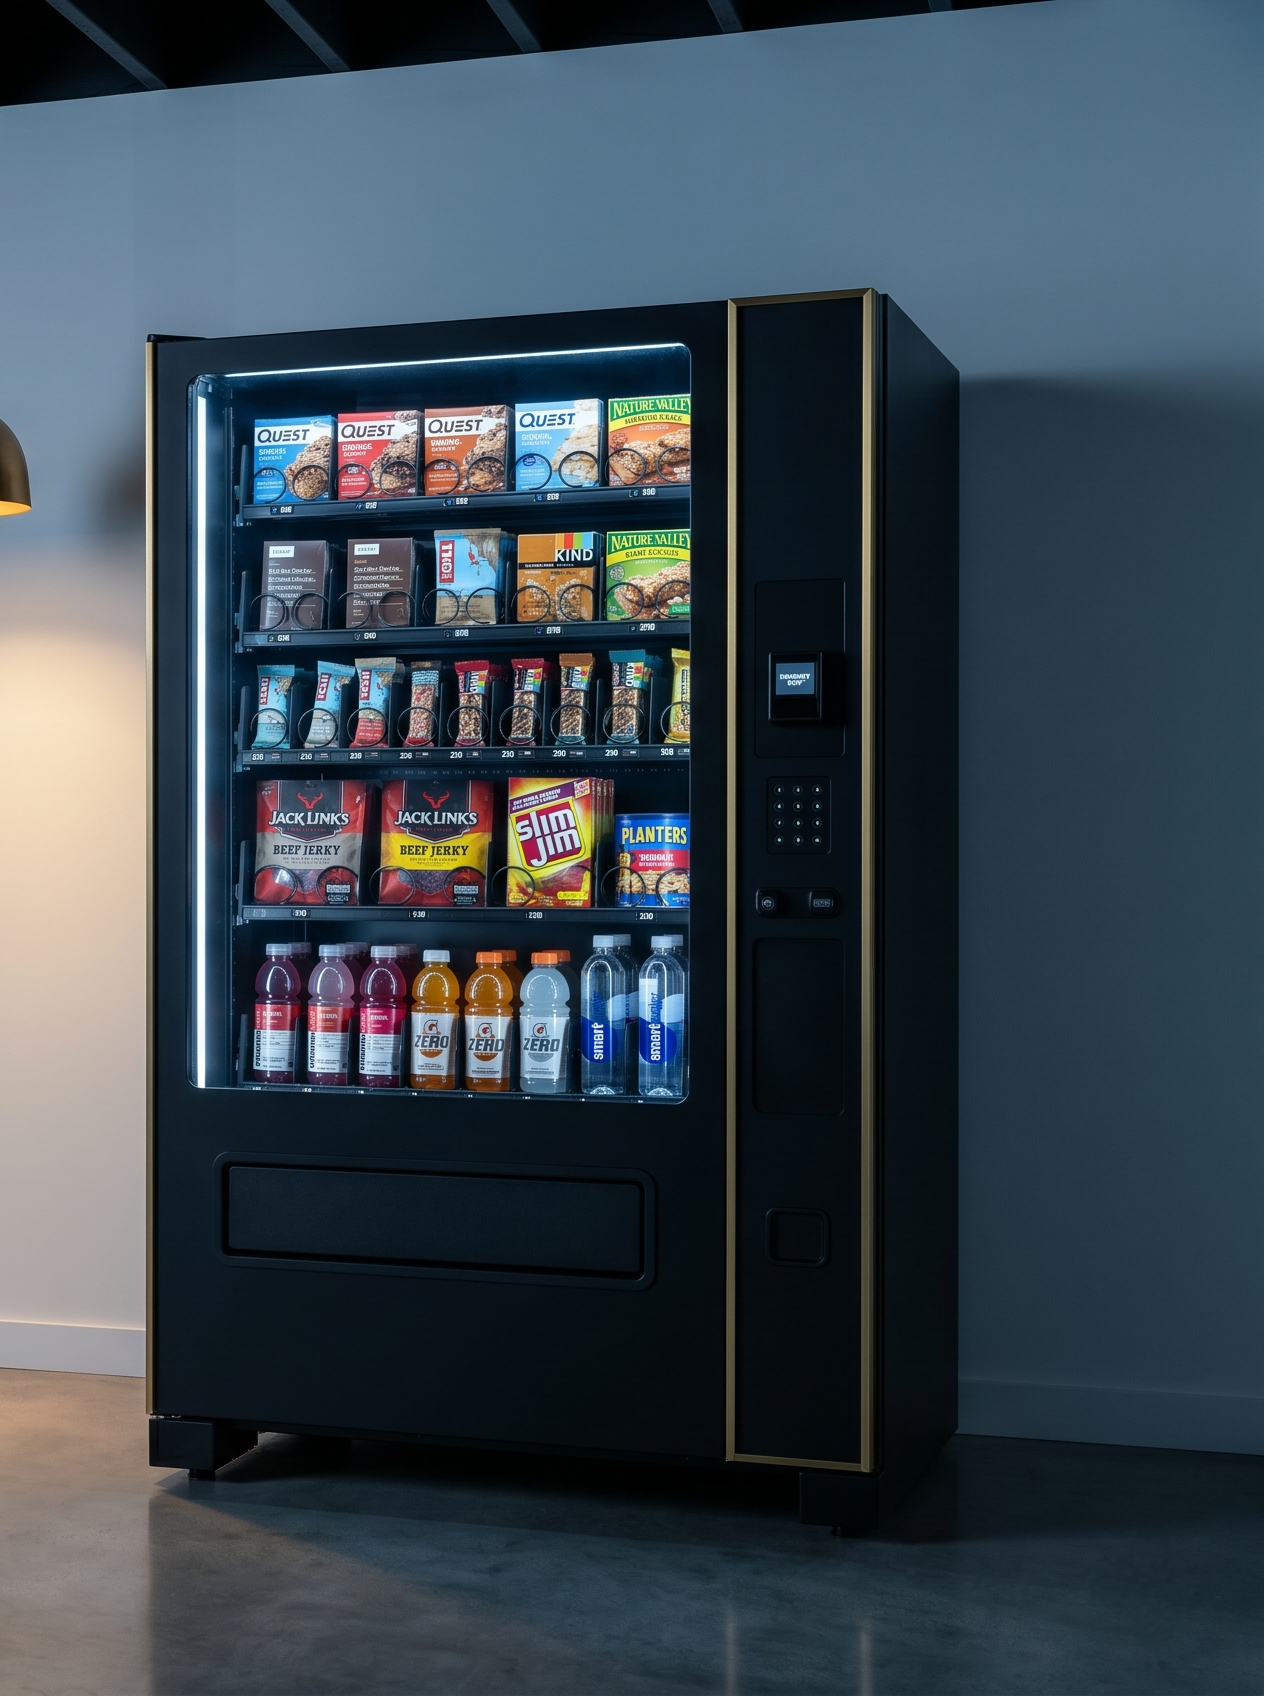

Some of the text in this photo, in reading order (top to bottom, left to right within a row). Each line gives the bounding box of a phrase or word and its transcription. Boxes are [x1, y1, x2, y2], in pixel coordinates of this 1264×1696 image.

[613, 399, 655, 419] NATURE
[428, 418, 483, 434] QUEST
[519, 412, 576, 428] QUEST
[257, 428, 310, 444] QUEST
[340, 423, 395, 439] QUEST
[611, 534, 654, 552] NATURE
[555, 548, 594, 562] KIND
[268, 810, 305, 826] JACK
[394, 811, 478, 826] JACK LINKS
[621, 825, 688, 845] PLANTERS
[273, 844, 341, 856] BEEF JERKY
[400, 845, 469, 858] BEEF JERKY
[415, 1034, 450, 1049] ZERO
[523, 1037, 561, 1052] ZERO
